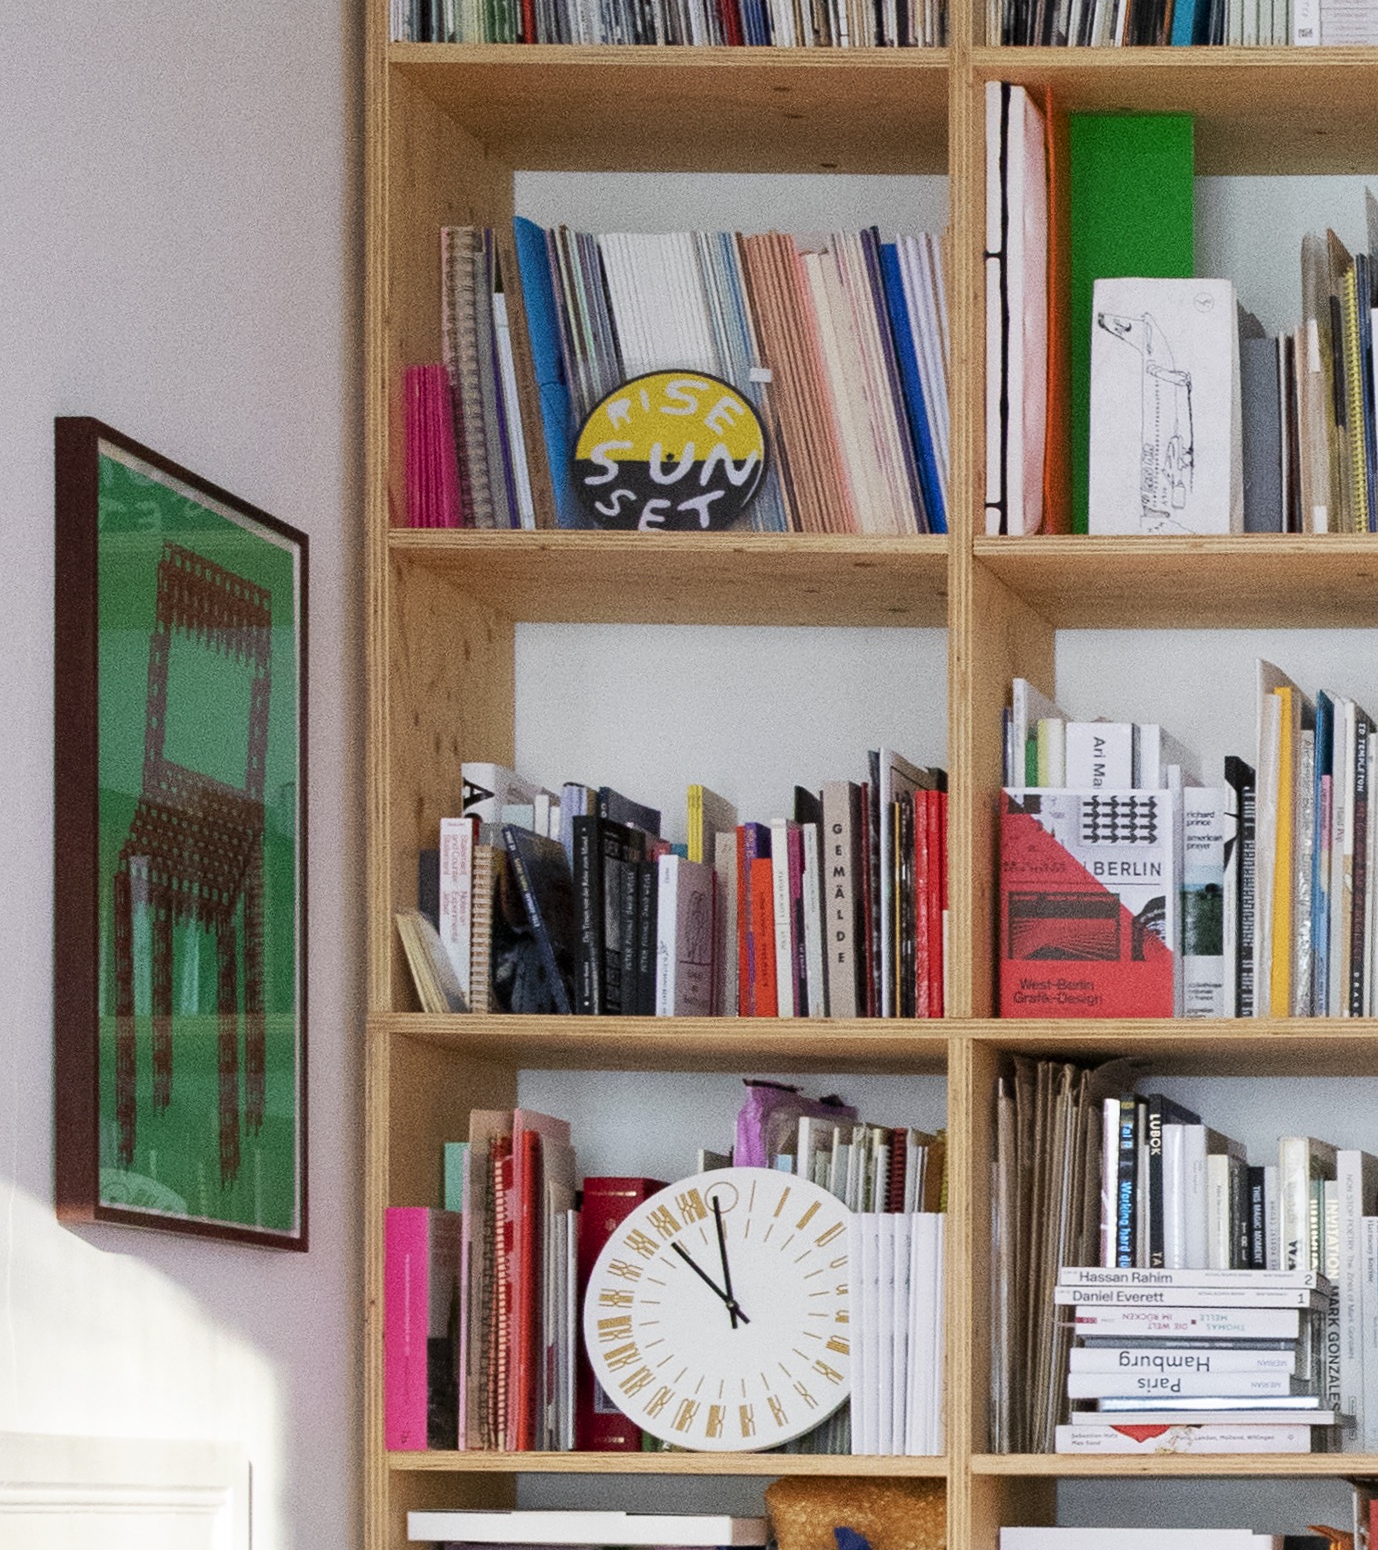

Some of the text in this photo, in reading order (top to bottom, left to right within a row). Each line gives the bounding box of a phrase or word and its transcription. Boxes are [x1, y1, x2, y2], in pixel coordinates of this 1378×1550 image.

[584, 442, 762, 487] SUN
[1092, 736, 1106, 760] Ari
[1092, 861, 1162, 877] BERLIN
[1149, 1113, 1161, 1155] LUBOK
[1079, 1271, 1313, 1285] Hassan Rahim 2
[1072, 1290, 1113, 1302] Daniel
[1116, 1290, 1165, 1303] Everett
[1326, 1199, 1340, 1411] INVITATION MARK GONZALES
[1137, 1377, 1181, 1393] Paris
